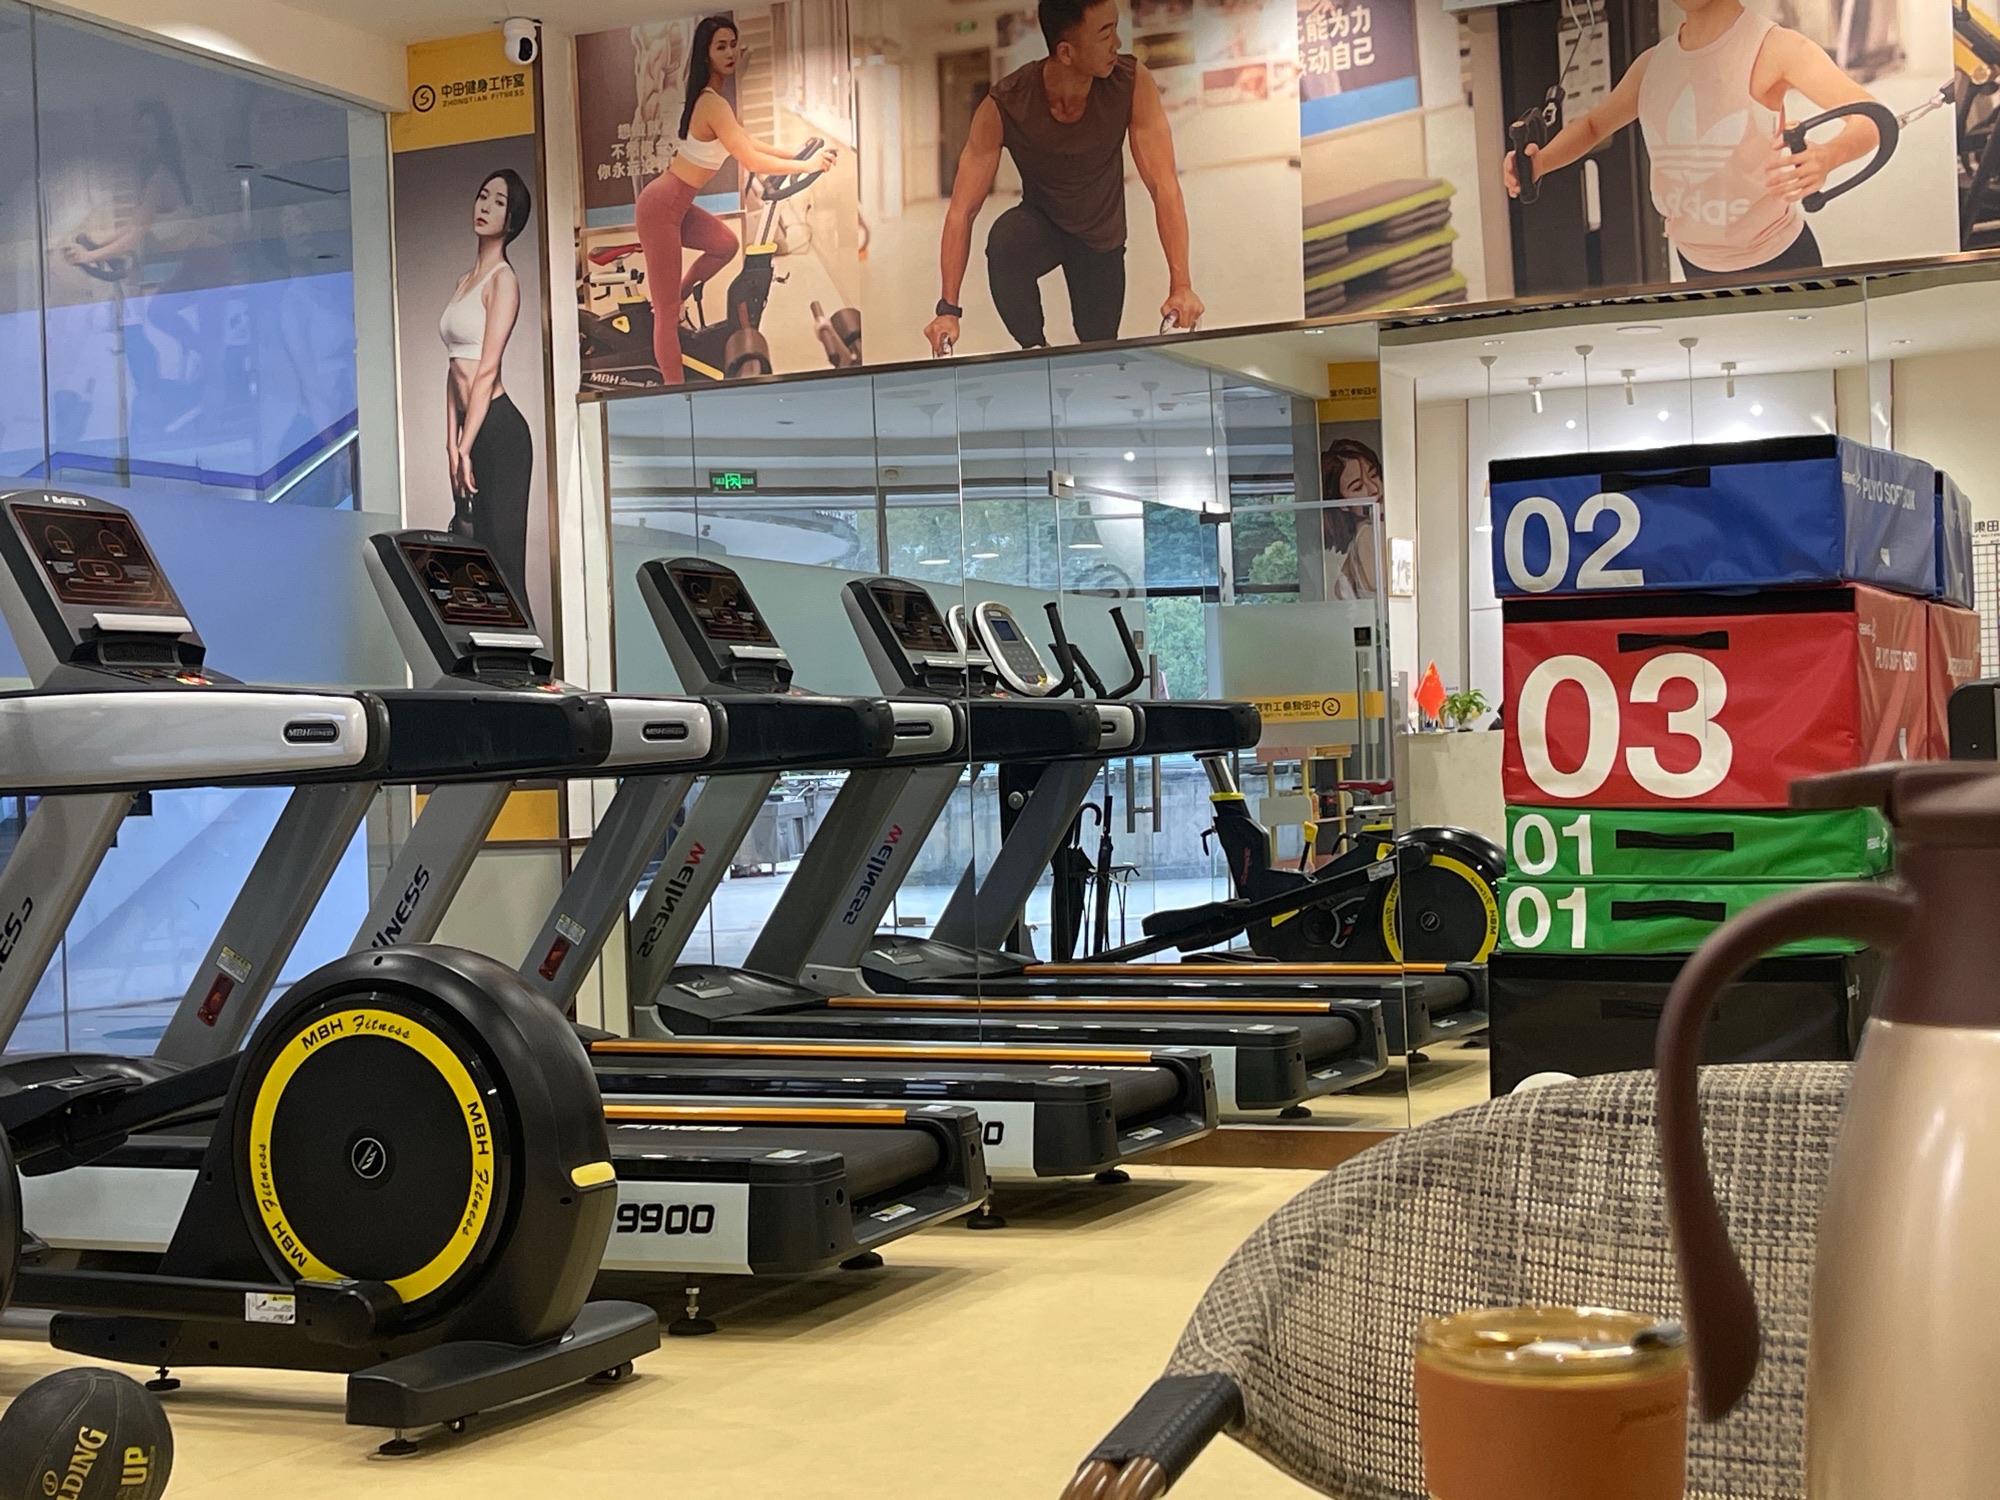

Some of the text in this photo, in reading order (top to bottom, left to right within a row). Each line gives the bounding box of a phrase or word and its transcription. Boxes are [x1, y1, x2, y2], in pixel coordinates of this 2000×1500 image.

[1298, 4, 1371, 44] 能为力
[441, 73, 525, 98] 中田健身工作室
[442, 89, 525, 108] ZHONGTIAN FITNESS
[590, 372, 619, 385] MBH
[1503, 493, 1645, 593] 02
[1517, 652, 1733, 799] 03
[1511, 814, 1594, 876] 01
[1505, 886, 1587, 949] 01
[301, 1014, 410, 1050] MBH Fitness
[462, 1101, 489, 1236] MBH Fitness
[258, 1143, 308, 1267] MBH Fitness
[616, 1203, 715, 1235] 9900
[120, 1446, 149, 1486] UP
